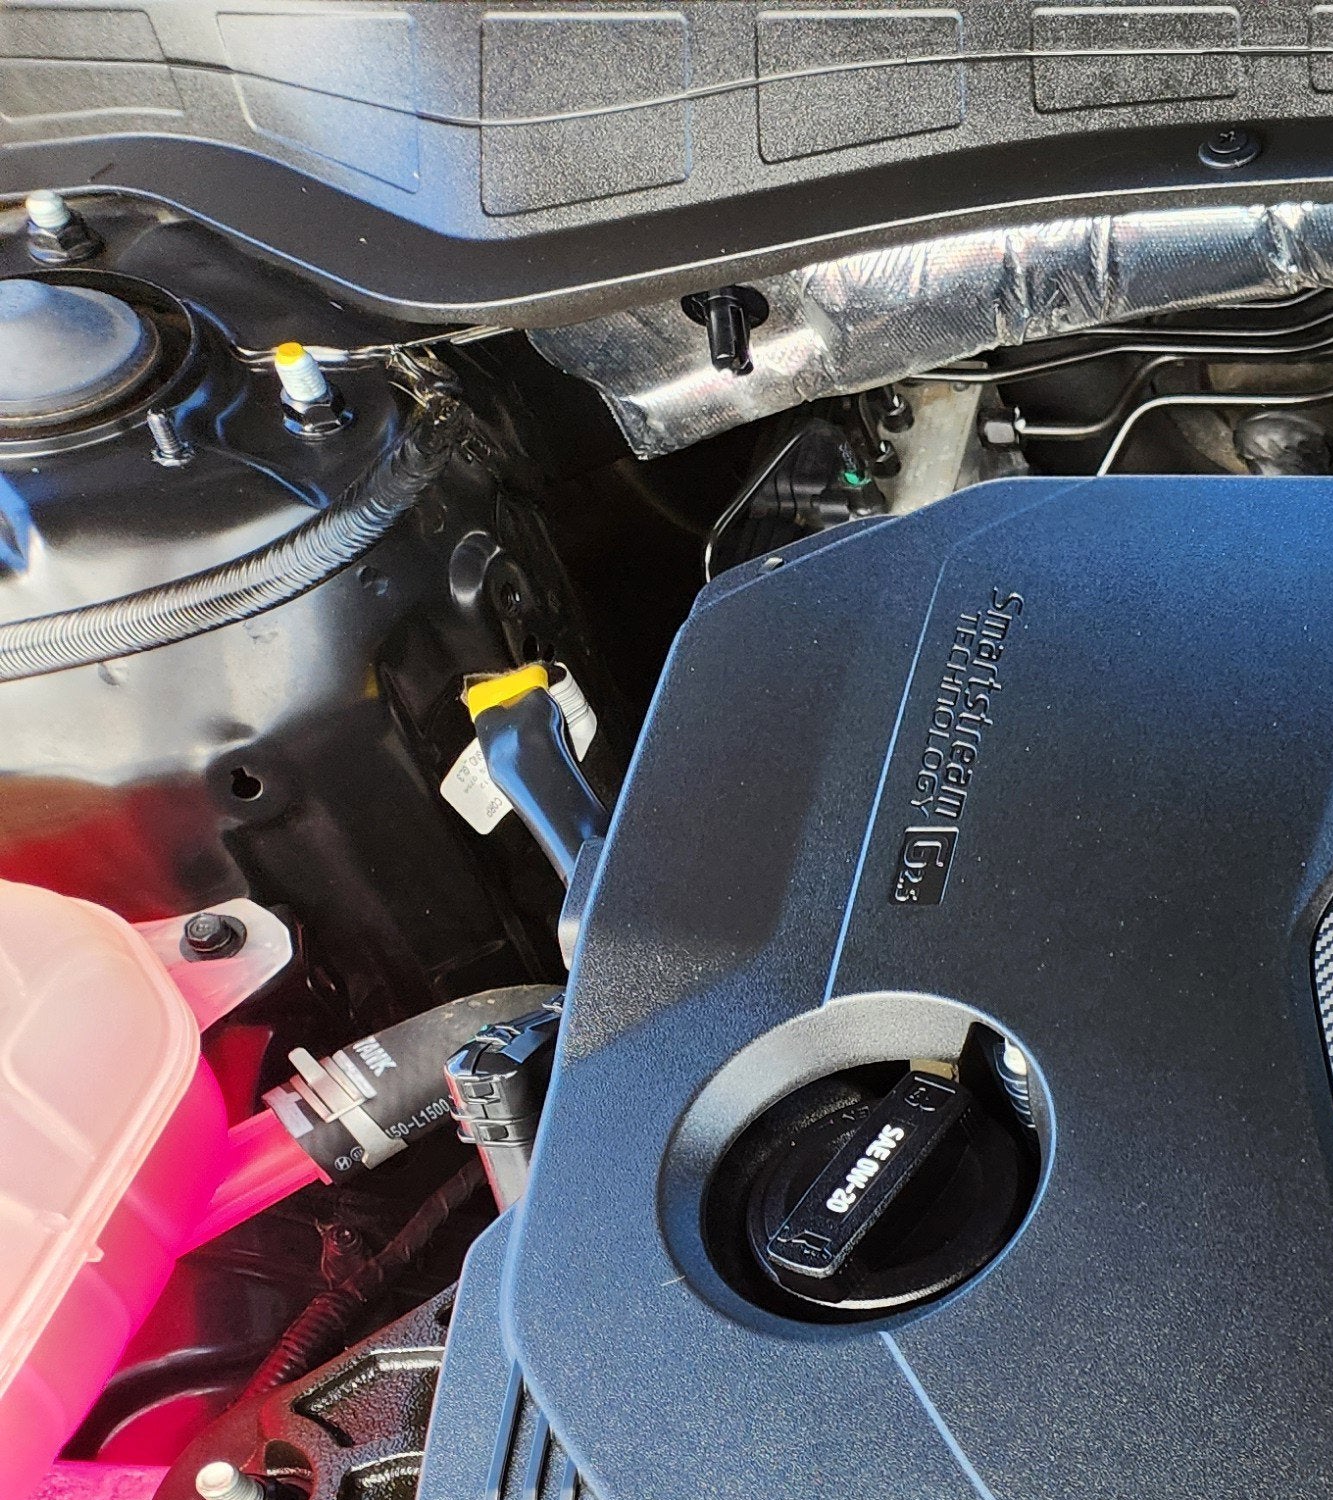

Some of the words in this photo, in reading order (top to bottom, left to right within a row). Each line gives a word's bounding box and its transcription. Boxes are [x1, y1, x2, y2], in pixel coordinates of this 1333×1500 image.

[909, 610, 981, 819] TECHNOLOGY
[936, 586, 1024, 821] Smartstream
[352, 1036, 397, 1078] TANK
[866, 1123, 905, 1162] SAE
[826, 1157, 881, 1213] 0W-20
